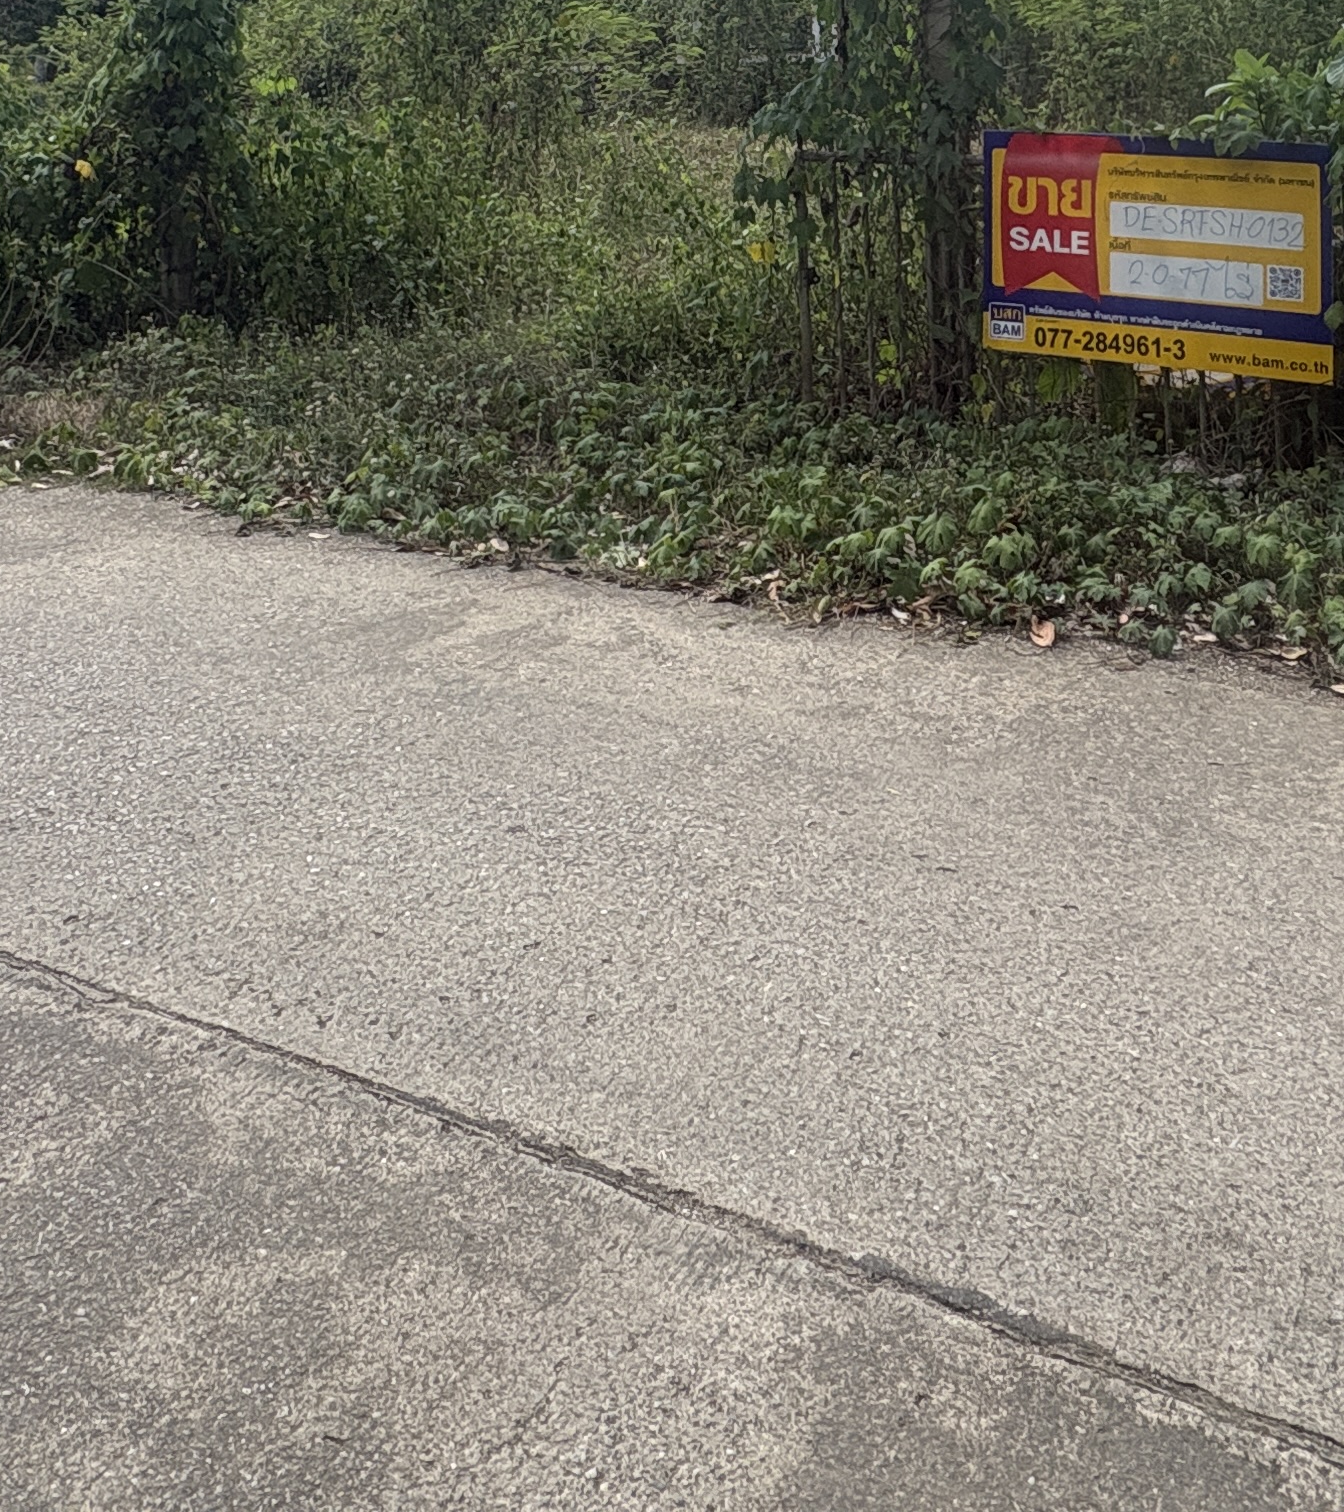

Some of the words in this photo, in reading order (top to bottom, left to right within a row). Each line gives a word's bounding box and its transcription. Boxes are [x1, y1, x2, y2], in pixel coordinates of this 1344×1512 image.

[1007, 175, 1092, 218] ขาย
[1009, 226, 1090, 255] SALE
[992, 306, 1022, 321] บสก
[992, 323, 1022, 337] BAM
[1034, 326, 1186, 361] 077-284961-3
[1208, 351, 1330, 376] www.bam.co.th
